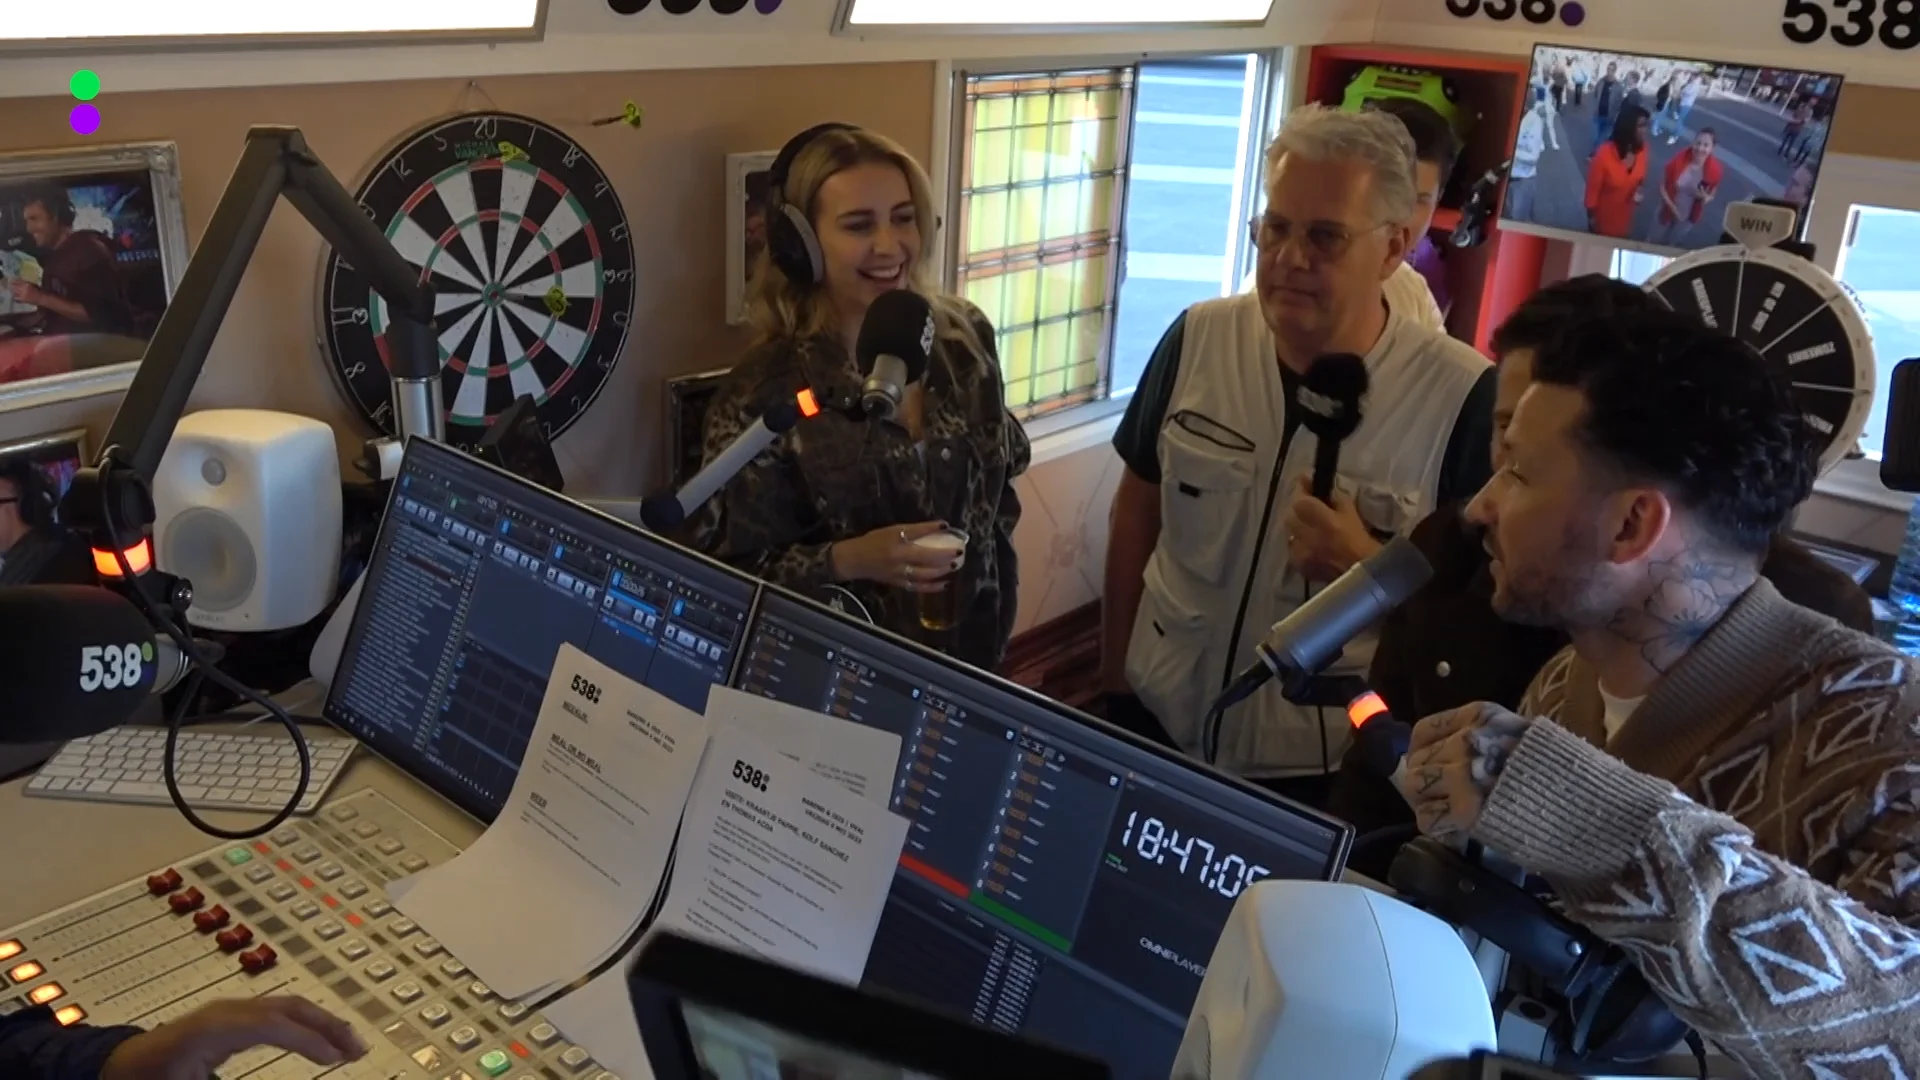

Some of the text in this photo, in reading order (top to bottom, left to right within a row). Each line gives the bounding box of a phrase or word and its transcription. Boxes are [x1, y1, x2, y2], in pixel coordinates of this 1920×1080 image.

[1782, 0, 1920, 50] 538
[1740, 216, 1773, 234] WIN
[80, 643, 141, 692] 538
[571, 673, 596, 701] 538
[732, 759, 763, 788] 538
